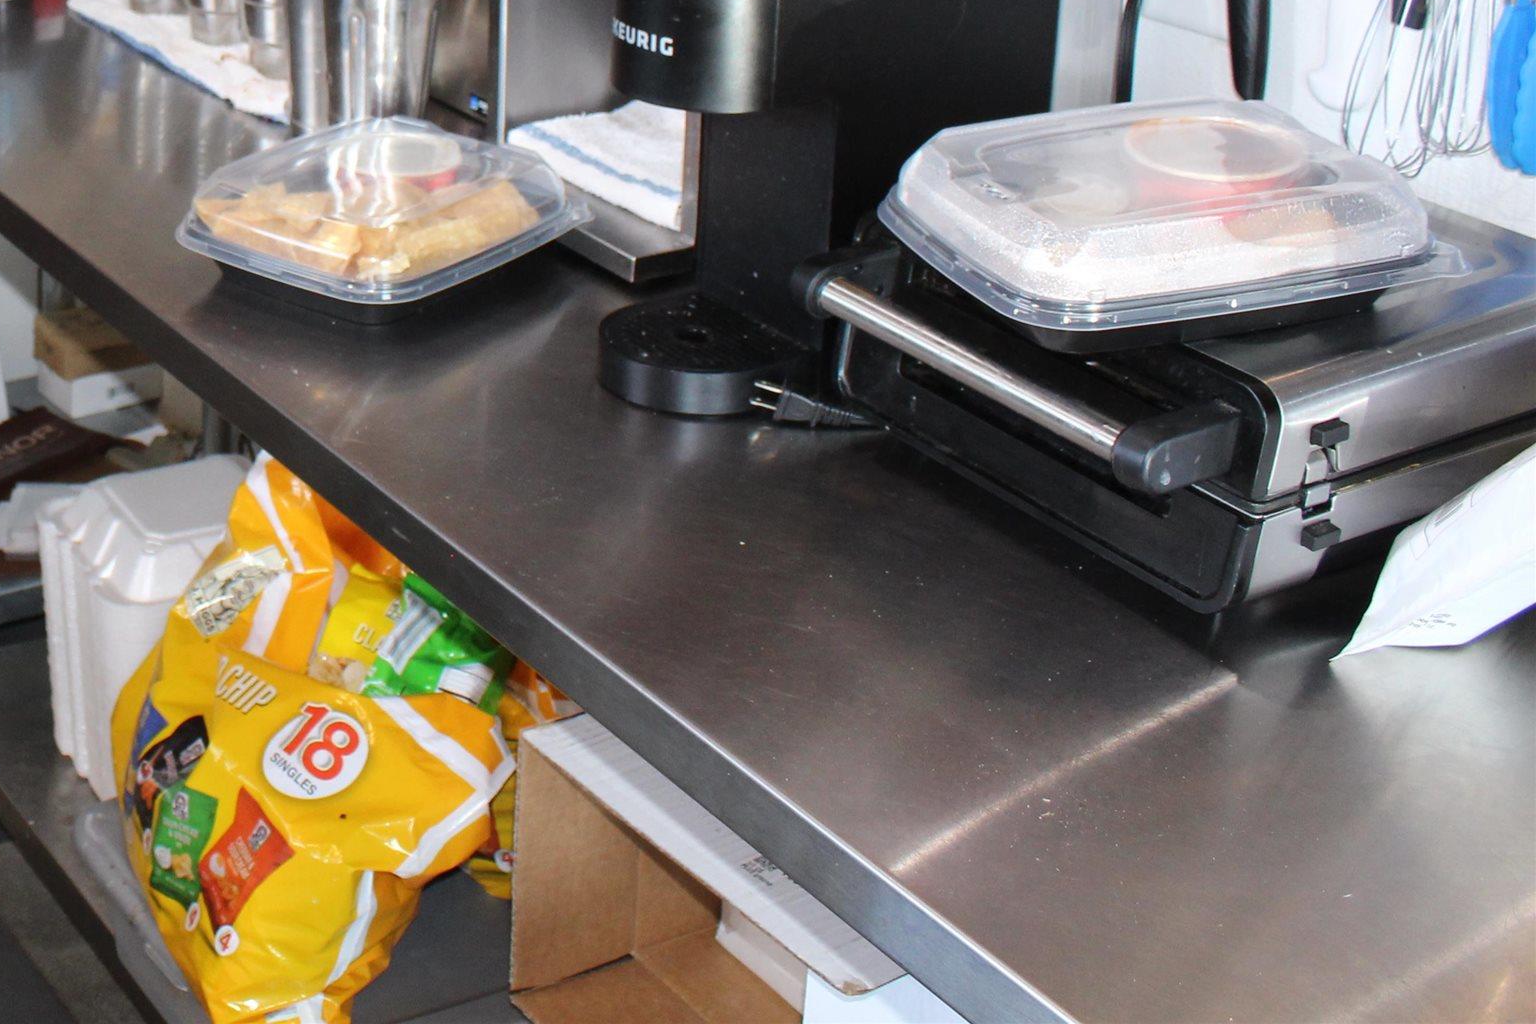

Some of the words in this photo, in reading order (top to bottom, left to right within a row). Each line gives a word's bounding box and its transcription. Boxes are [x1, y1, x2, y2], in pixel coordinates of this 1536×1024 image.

[613, 17, 674, 57] KEURIG
[282, 702, 360, 781] 18
[269, 752, 318, 796] SINGLES
